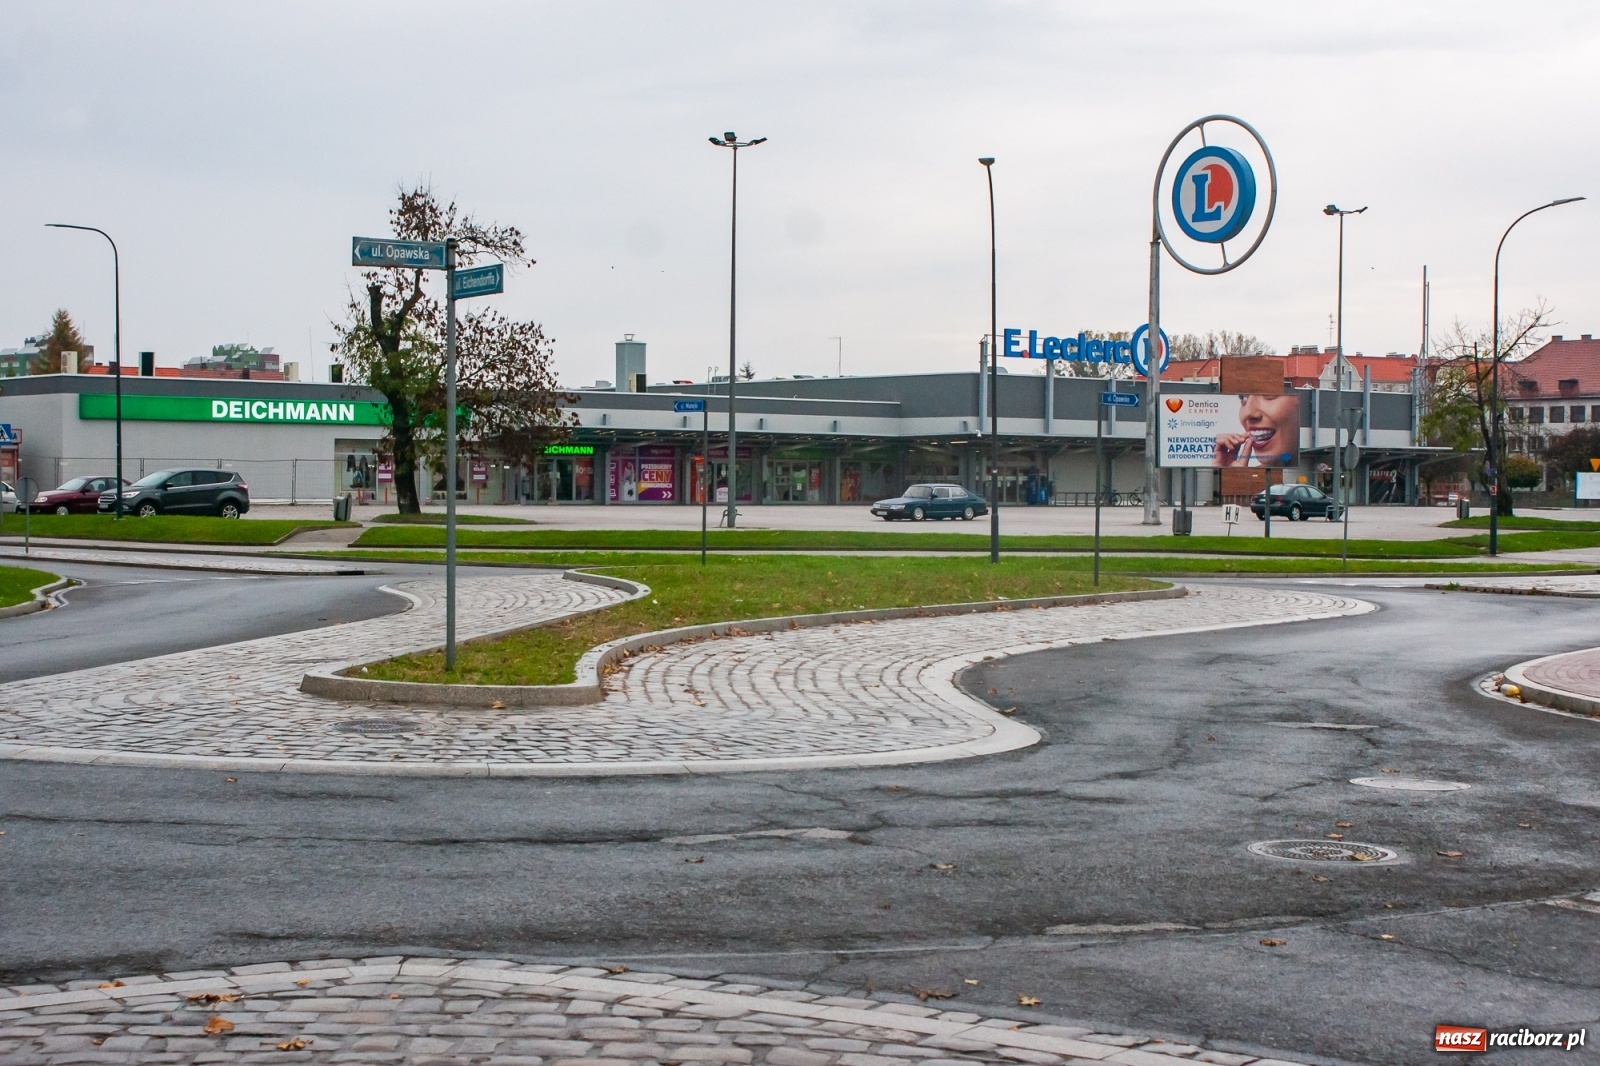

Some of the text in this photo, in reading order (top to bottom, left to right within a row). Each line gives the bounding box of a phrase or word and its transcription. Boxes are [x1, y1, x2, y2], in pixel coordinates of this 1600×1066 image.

[1191, 173, 1222, 223] L
[371, 245, 430, 260] ul. Opawska
[463, 272, 495, 289] Eichendorffa
[1003, 328, 1131, 364] E.Leclerc
[211, 400, 355, 421] DEICHMANN
[1188, 399, 1219, 408] Dentica
[1168, 443, 1217, 453] APARATY
[641, 469, 673, 483] CENY
